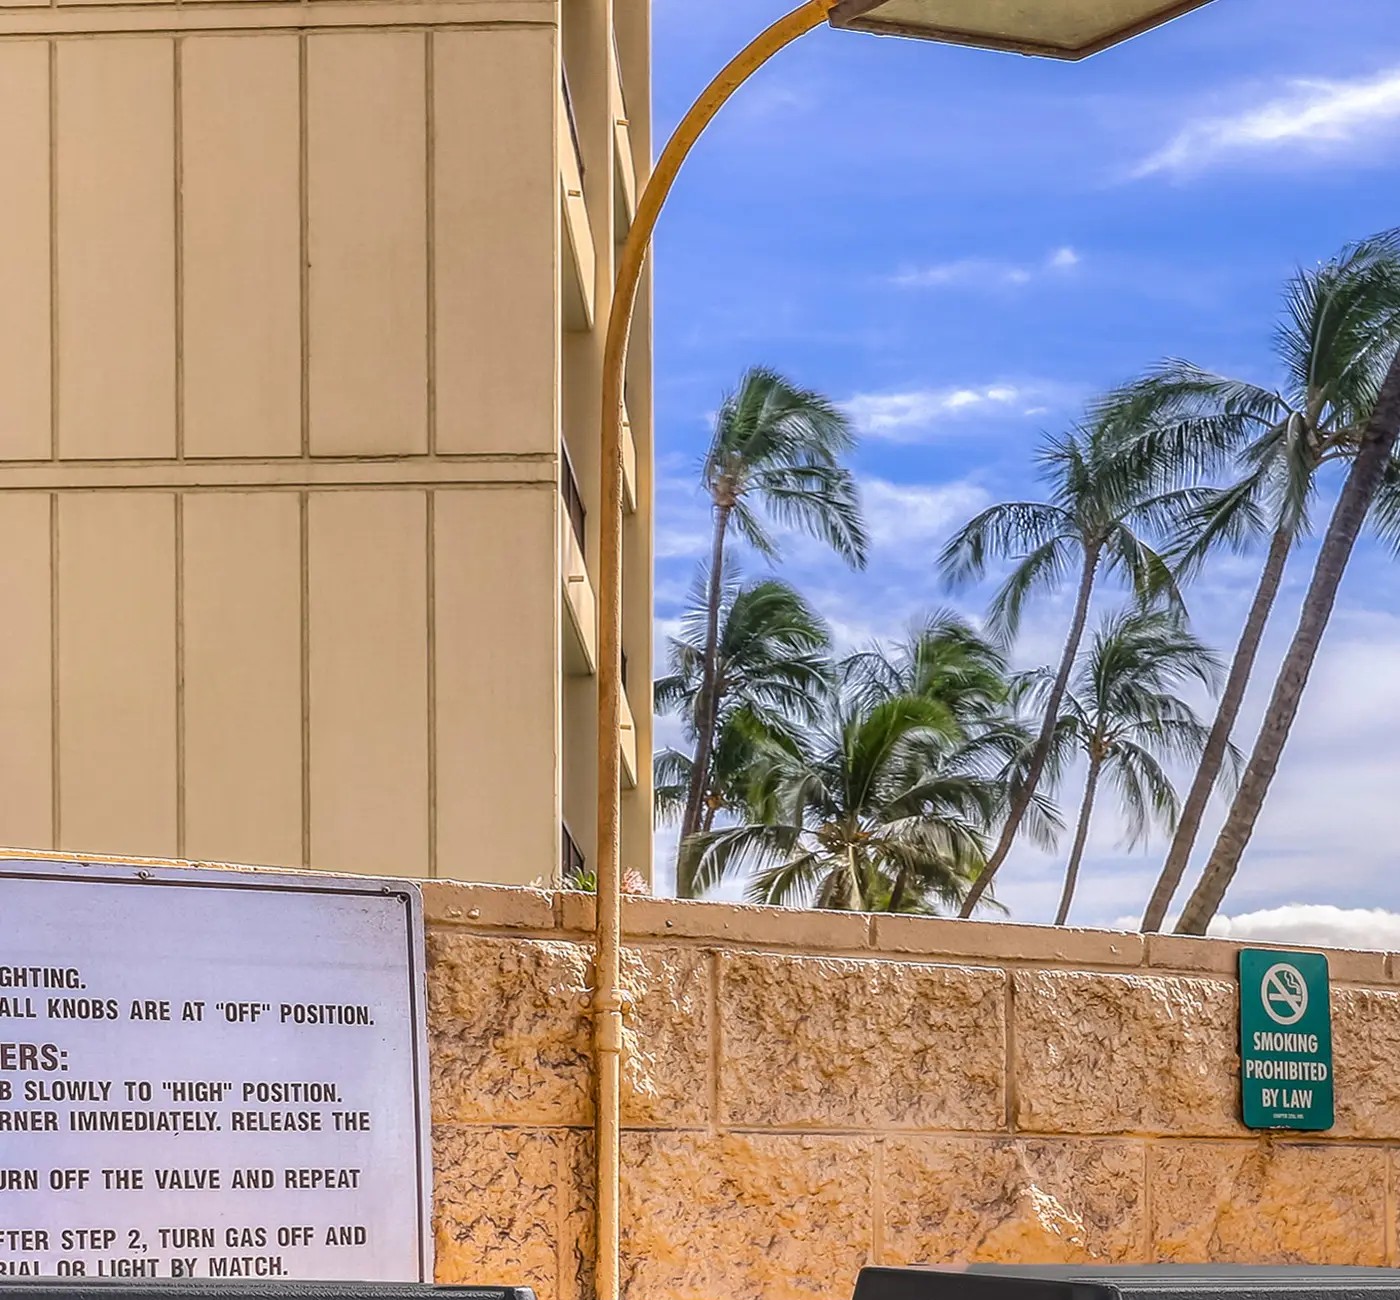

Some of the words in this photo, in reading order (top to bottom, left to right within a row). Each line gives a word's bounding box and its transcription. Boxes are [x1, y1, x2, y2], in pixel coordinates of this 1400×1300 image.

[0, 966, 86, 989] GHTING.
[0, 998, 36, 1018] ALL
[48, 999, 118, 1020] KNOBS
[130, 1001, 171, 1020] ARE
[182, 1002, 205, 1021] AT
[215, 1002, 270, 1022] "OFF"
[280, 1004, 374, 1025] POSITION.
[1253, 1032, 1318, 1053] SMOKING
[0, 1043, 69, 1071] ERS:
[1246, 1060, 1328, 1081] PROHIBITED
[25, 1081, 112, 1102] SLOWLY
[124, 1081, 152, 1101] TO
[162, 1082, 232, 1101] "HIGH"
[243, 1083, 342, 1102] POSITION.
[1261, 1088, 1279, 1108] BY
[1282, 1089, 1313, 1108] LAW
[0, 1112, 58, 1131] RNER
[70, 1111, 221, 1131] IMMEDIATELY.
[231, 1112, 322, 1131] RELEASE
[332, 1112, 370, 1131] THE
[50, 1170, 90, 1190] OFF
[102, 1170, 143, 1189] THE
[155, 1170, 221, 1189] VALVE
[231, 1170, 274, 1189] AND
[285, 1169, 361, 1189] REPEAT
[61, 1230, 116, 1250] STEP
[128, 1230, 147, 1252] 2,
[158, 1229, 215, 1249] TURN
[226, 1228, 267, 1248] GAS
[277, 1227, 314, 1247] OFF
[325, 1227, 366, 1246] AND
[57, 1261, 86, 1277] OR
[98, 1259, 160, 1278] LIGHT
[171, 1258, 198, 1278] BY
[209, 1257, 288, 1277] MATCH.
